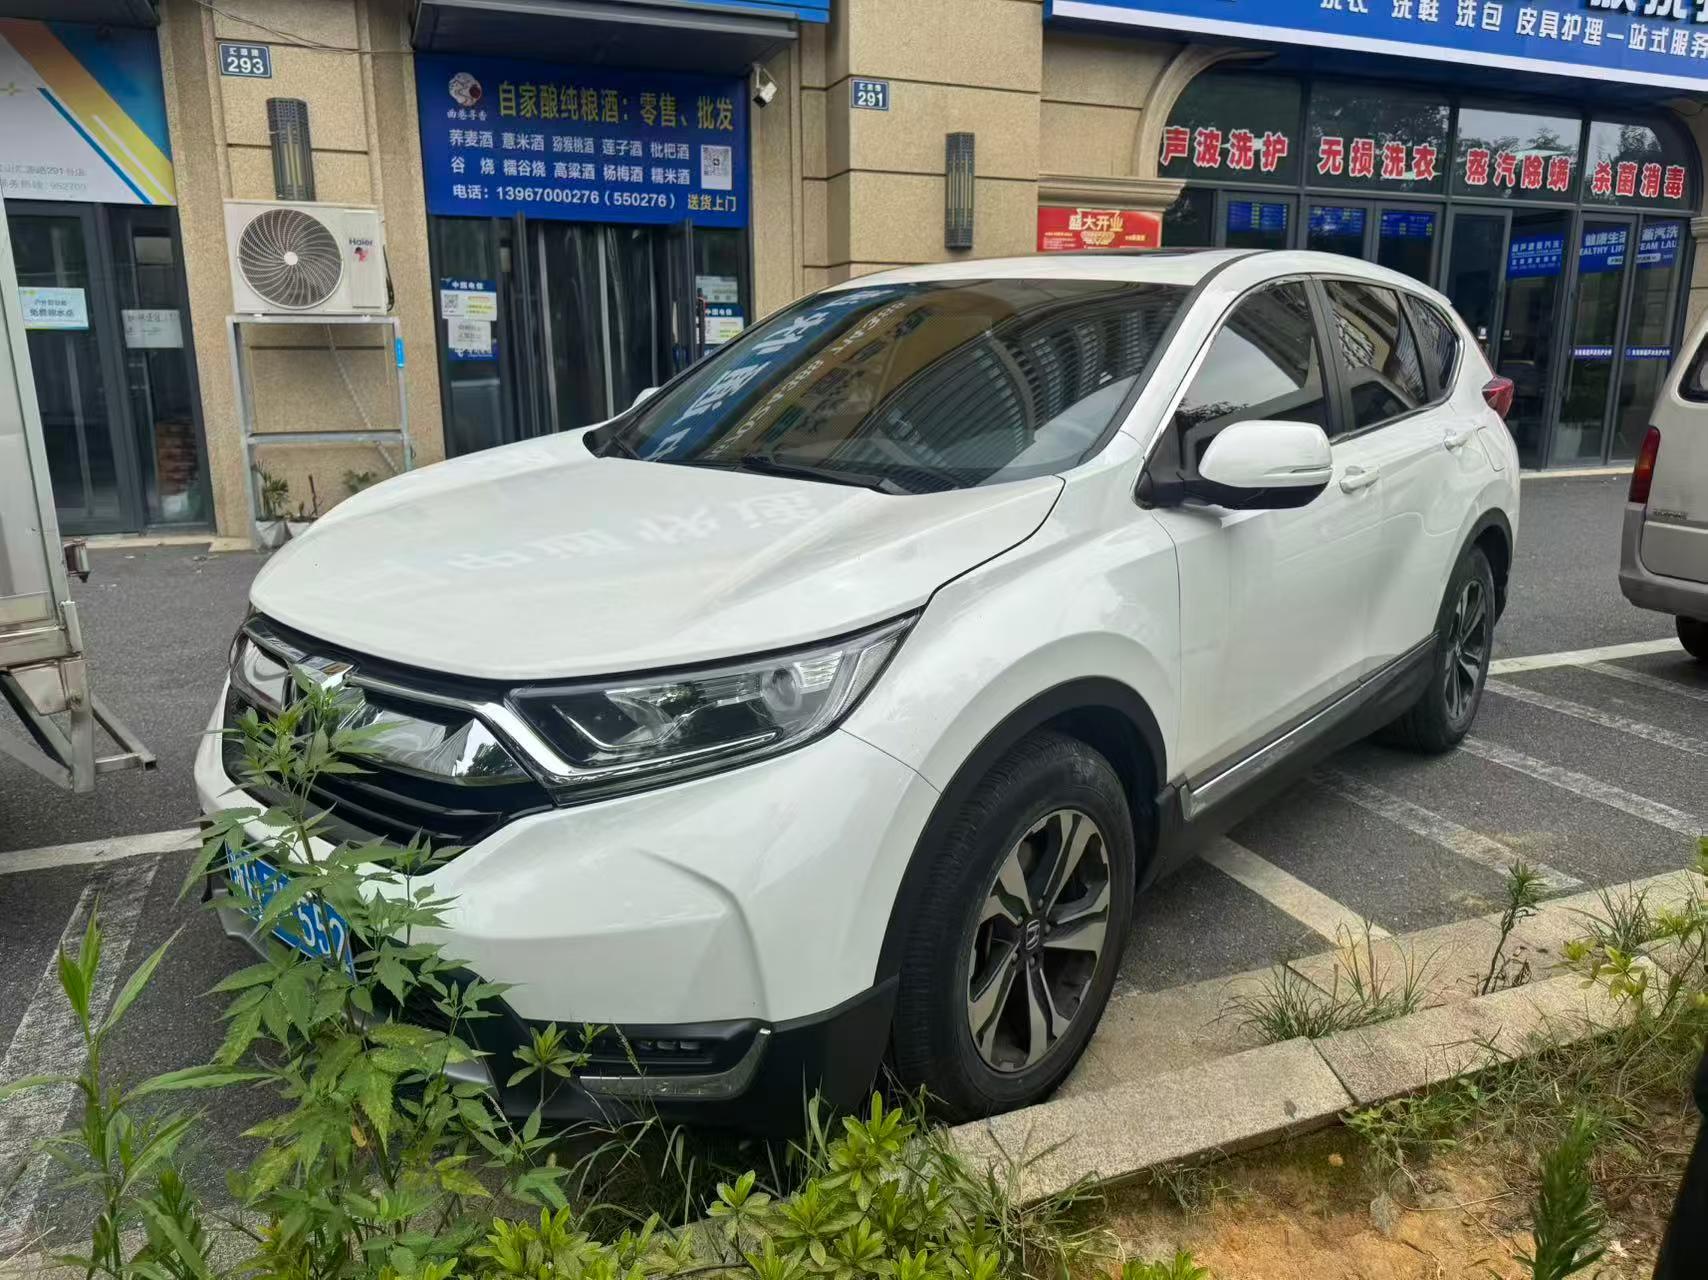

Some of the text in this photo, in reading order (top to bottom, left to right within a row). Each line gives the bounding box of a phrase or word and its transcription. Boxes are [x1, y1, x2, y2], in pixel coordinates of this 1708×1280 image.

[1455, 0, 1503, 31] 洗包
[1515, 6, 1708, 58] 皮具护理一站式服务
[227, 57, 264, 74] 293
[858, 91, 883, 107] 291
[449, 129, 690, 160] 荞麦酒 薏米酒 猕猴桃酒 莲子酒 枇杷酒
[1160, 126, 1288, 172] 声波洗护
[1318, 136, 1436, 180] 无损洗衣
[503, 158, 546, 178] 糯谷烧
[603, 164, 644, 183] 杨梅酒
[651, 167, 690, 185] 糯米酒
[1465, 148, 1570, 191] 蒸汽除螨
[1591, 161, 1685, 199] 杀菌消毒
[688, 192, 737, 212] 送货上门
[1068, 214, 1124, 232] 盛大开业
